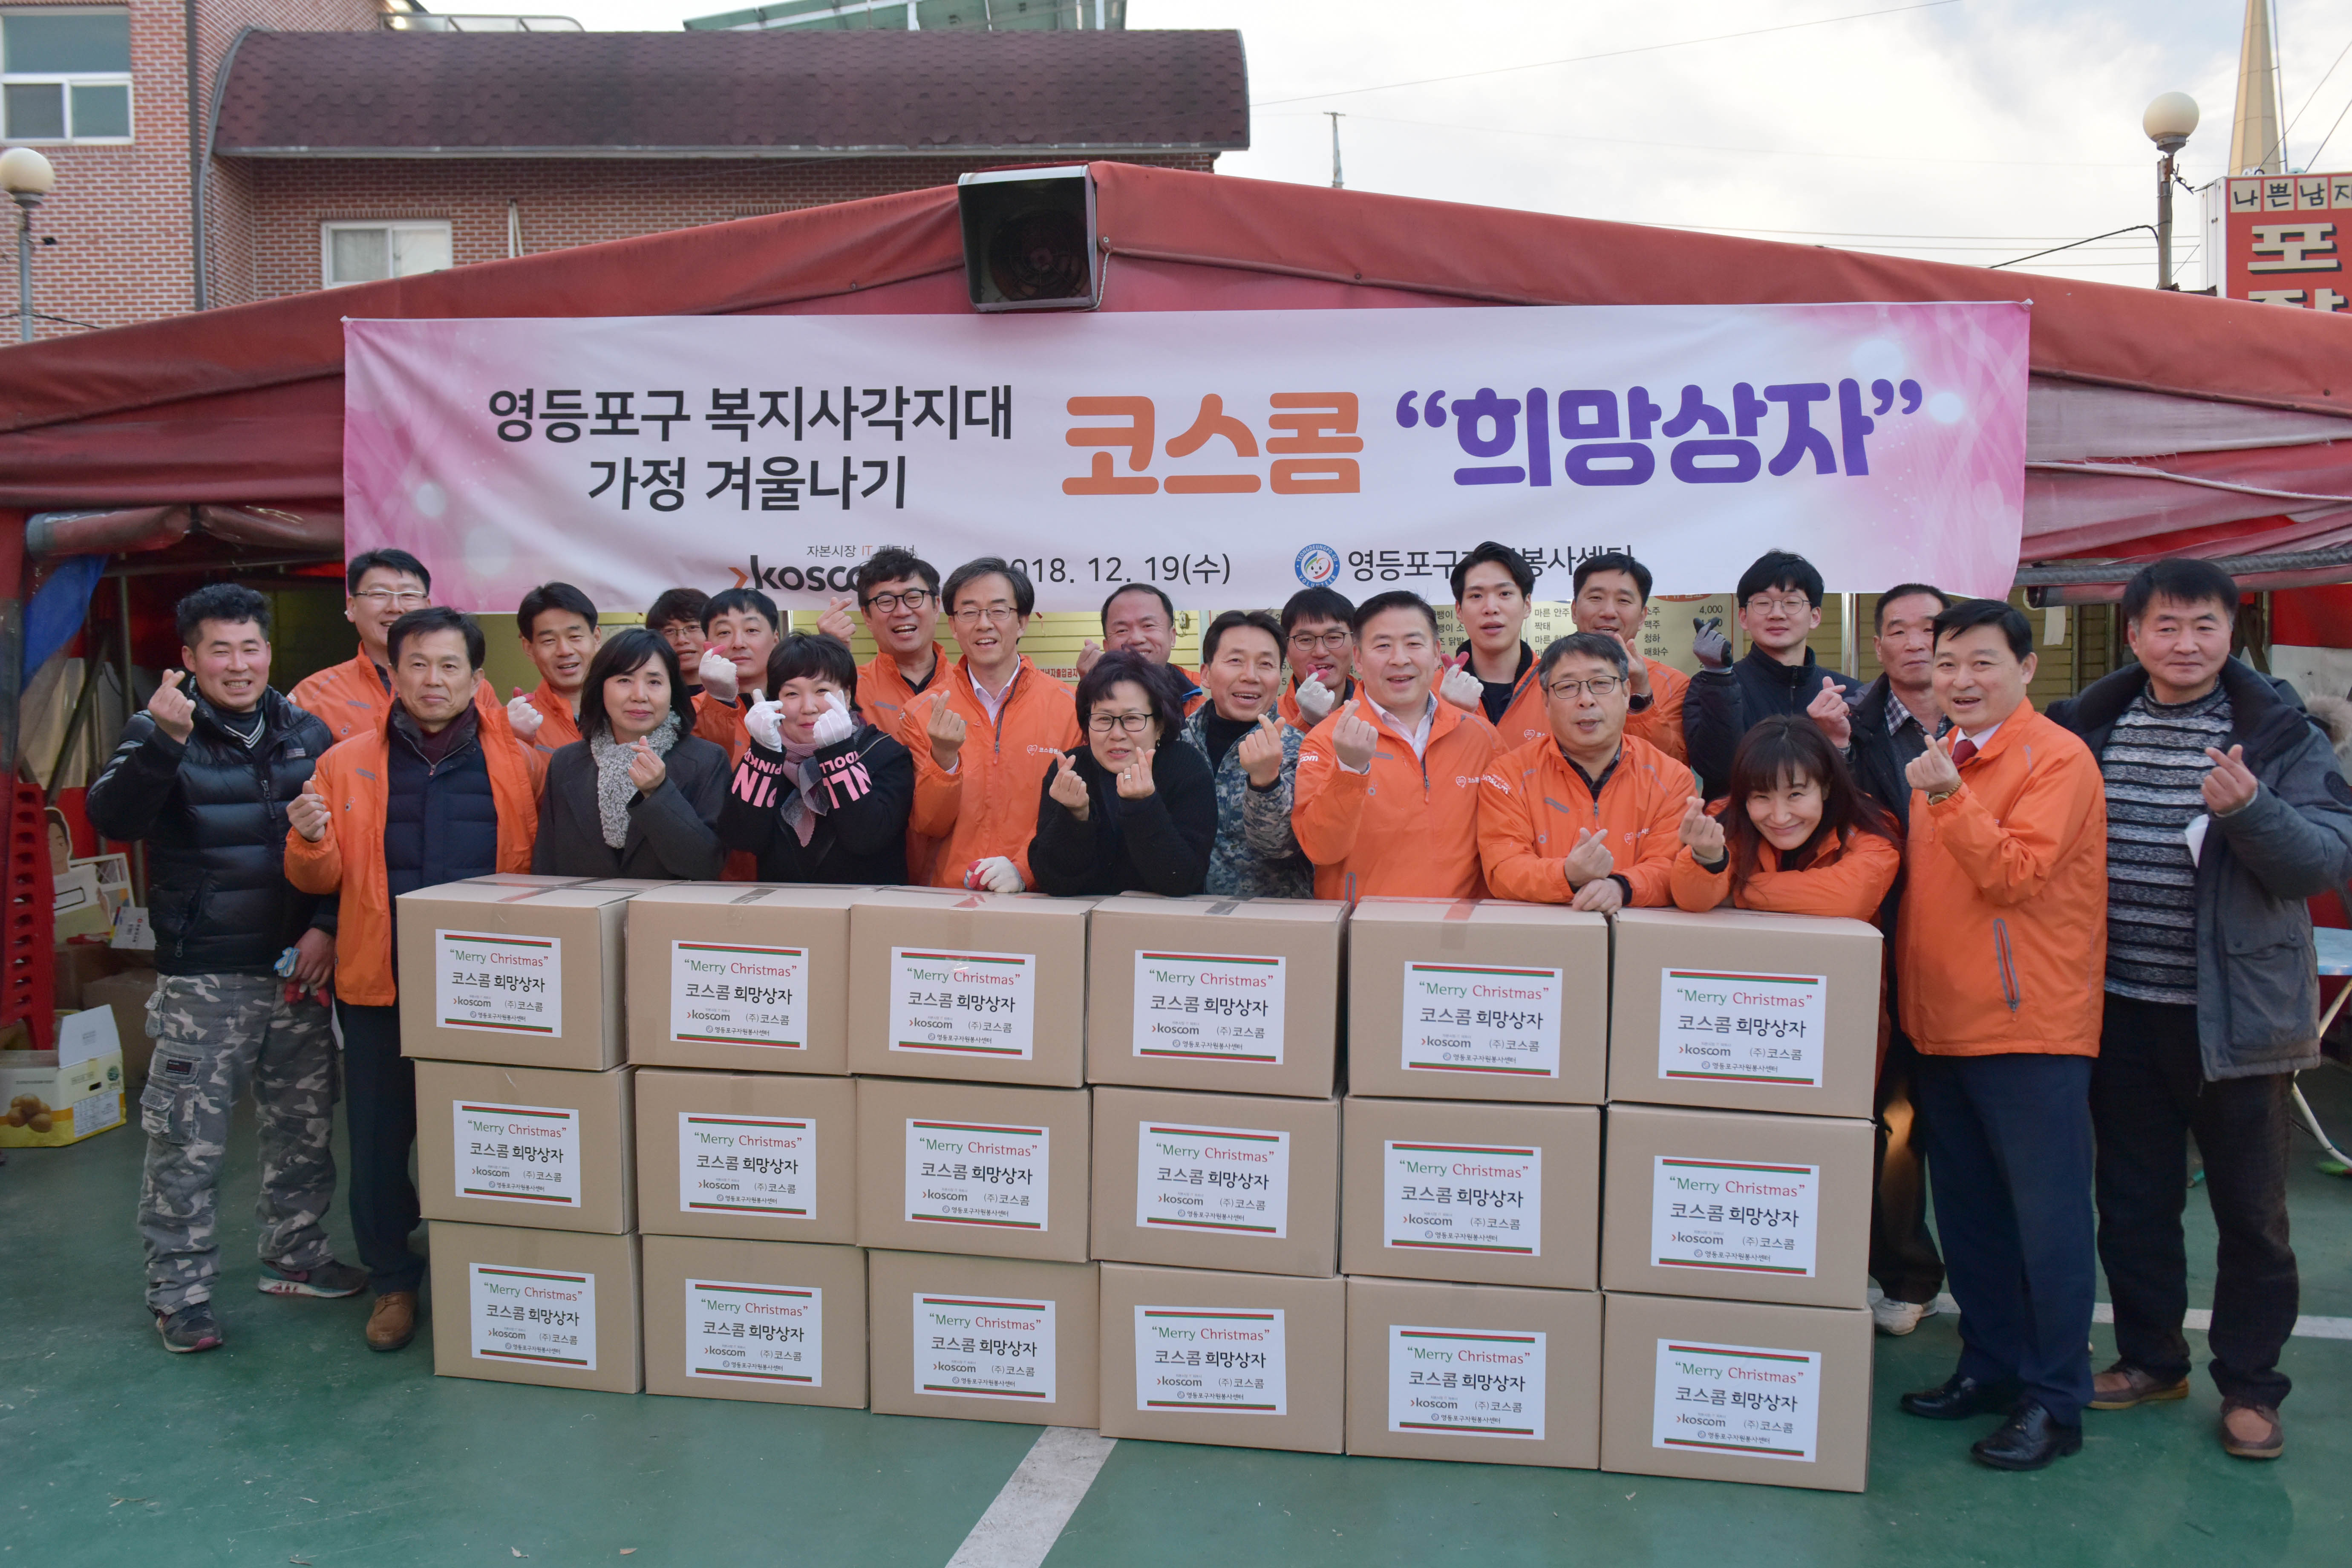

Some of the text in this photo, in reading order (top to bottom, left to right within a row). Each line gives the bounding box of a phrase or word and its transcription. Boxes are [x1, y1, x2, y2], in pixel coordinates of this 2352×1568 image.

[489, 385, 1012, 443] 영등포구 복지사각지대
[1062, 378, 1923, 495] 코스콤 “희망상자”
[588, 455, 906, 512] 가정 겨울나기
[807, 545, 856, 557] 자본시장
[862, 545, 873, 556] IT
[1088, 556, 1131, 582] 12.
[1144, 553, 1231, 585] 19(수)
[1534, 608, 1570, 617] 마른 안주
[1699, 605, 1723, 614] 4,000
[1644, 620, 1660, 629] 맥주
[1535, 635, 1551, 644] 마른
[1644, 634, 1660, 643] 청하
[1644, 647, 1668, 657] 매화수
[450, 949, 548, 966] “Merry Christmas”
[685, 959, 796, 977] “Merry Christmas”
[908, 968, 949, 983] “Merry
[452, 972, 545, 992] 코스콤 희망상자
[1150, 970, 1273, 987] “Merry Christmas”
[686, 984, 792, 1005] 코스콤 희망상자
[1419, 982, 1548, 999] “Merry Christmas”
[1677, 989, 1812, 1007] “Merry Christmas”
[458, 996, 491, 1007] koscom
[908, 992, 1015, 1012] 코스콤 희망상자
[1151, 996, 1268, 1017] 코스콤 희망상자
[692, 1009, 729, 1021] koscom
[914, 1017, 952, 1029] koscom
[1420, 1008, 1543, 1029] 코스콤 희망상자
[1158, 1023, 1199, 1035] koscom
[1678, 1016, 1806, 1038] 코스콤 희망상자
[1427, 1036, 1470, 1048] koscom
[1686, 1044, 1730, 1056] koscom
[468, 1120, 566, 1137] “Merry Christmas”
[695, 1132, 801, 1148] “Merry Christmas”
[920, 1138, 1037, 1156] “Merry Christmas”
[470, 1143, 563, 1163] 코스콤 희망상자
[1156, 1143, 1274, 1162] “Merry Christmas”
[476, 1166, 509, 1177] koscom
[697, 1156, 798, 1174] 코스콤 희망상자
[1400, 1160, 1528, 1178] “Merry Christmas”
[921, 1163, 1033, 1185] 코스콤 희망상자
[1157, 1168, 1269, 1190] 코스콤 희망상자
[704, 1180, 739, 1190] koscom
[1670, 1176, 1804, 1196] “Merry Christmas”
[928, 1189, 967, 1201] koscom
[1164, 1193, 1203, 1205] koscom
[1401, 1186, 1523, 1208] 코스콤 희망상자
[1409, 1214, 1452, 1226] koscom
[1671, 1203, 1799, 1227] 코스콤 희망상자
[1678, 1232, 1723, 1245] koscom
[484, 1283, 582, 1301] “Merry Christmas”
[487, 1305, 579, 1326] 코스콤 희망상자
[701, 1299, 807, 1316] “Merry Christmas”
[930, 1313, 1041, 1330] “Merry Christmas”
[493, 1328, 525, 1339] koscom
[703, 1322, 804, 1342] 코스콤 희망상자
[1152, 1326, 1269, 1341] “Merry Christmas”
[710, 1346, 745, 1357] koscom
[931, 1337, 1037, 1357] 코스콤 희망상자
[1408, 1347, 1530, 1363] “Merry Christmas”
[939, 1361, 976, 1372] koscom
[1155, 1351, 1266, 1368] 코스콤 희망상자
[1162, 1376, 1202, 1386] koscom
[1675, 1362, 1803, 1384] “Merry Christmas”
[1409, 1372, 1525, 1392] 코스콤 희망상자
[1416, 1398, 1457, 1409] koscom
[1676, 1387, 1798, 1412] 코스콤 희망상자
[1683, 1414, 1725, 1427] koscom
